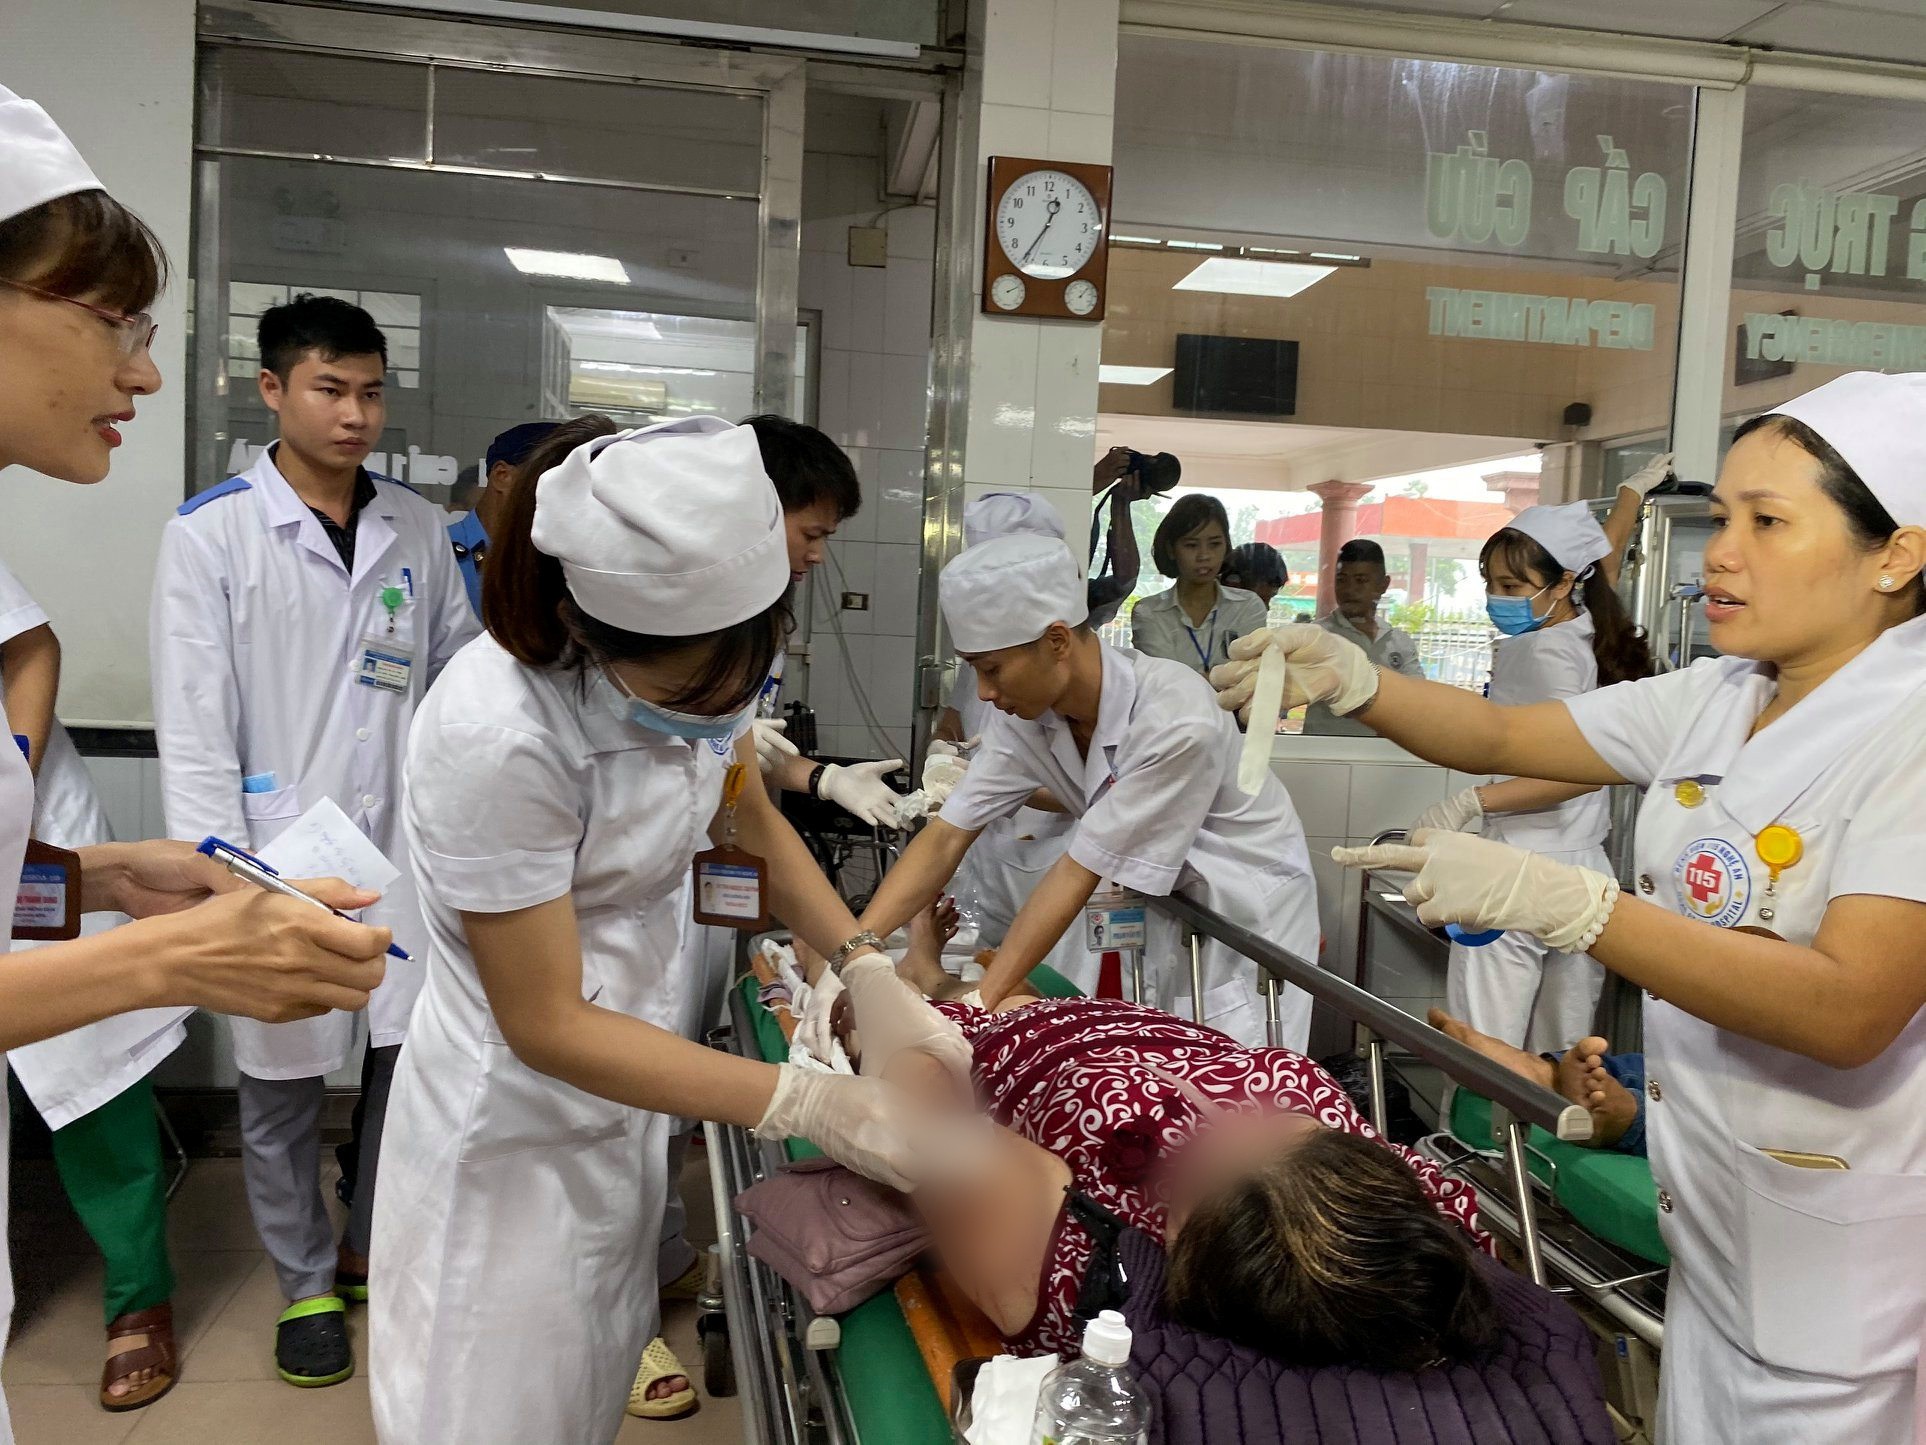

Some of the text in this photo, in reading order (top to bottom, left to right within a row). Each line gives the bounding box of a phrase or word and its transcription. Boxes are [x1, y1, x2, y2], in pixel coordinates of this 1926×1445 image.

[1027, 186, 1035, 197] 11
[1044, 182, 1054, 192] 12
[1013, 198, 1023, 209] 10
[1078, 203, 1084, 213] 2
[1008, 217, 1015, 228] 9
[1081, 223, 1088, 234] 3
[1012, 238, 1018, 248] 8
[1075, 242, 1082, 253] 4
[1062, 256, 1068, 266] 5
[1689, 867, 1716, 889] 115
